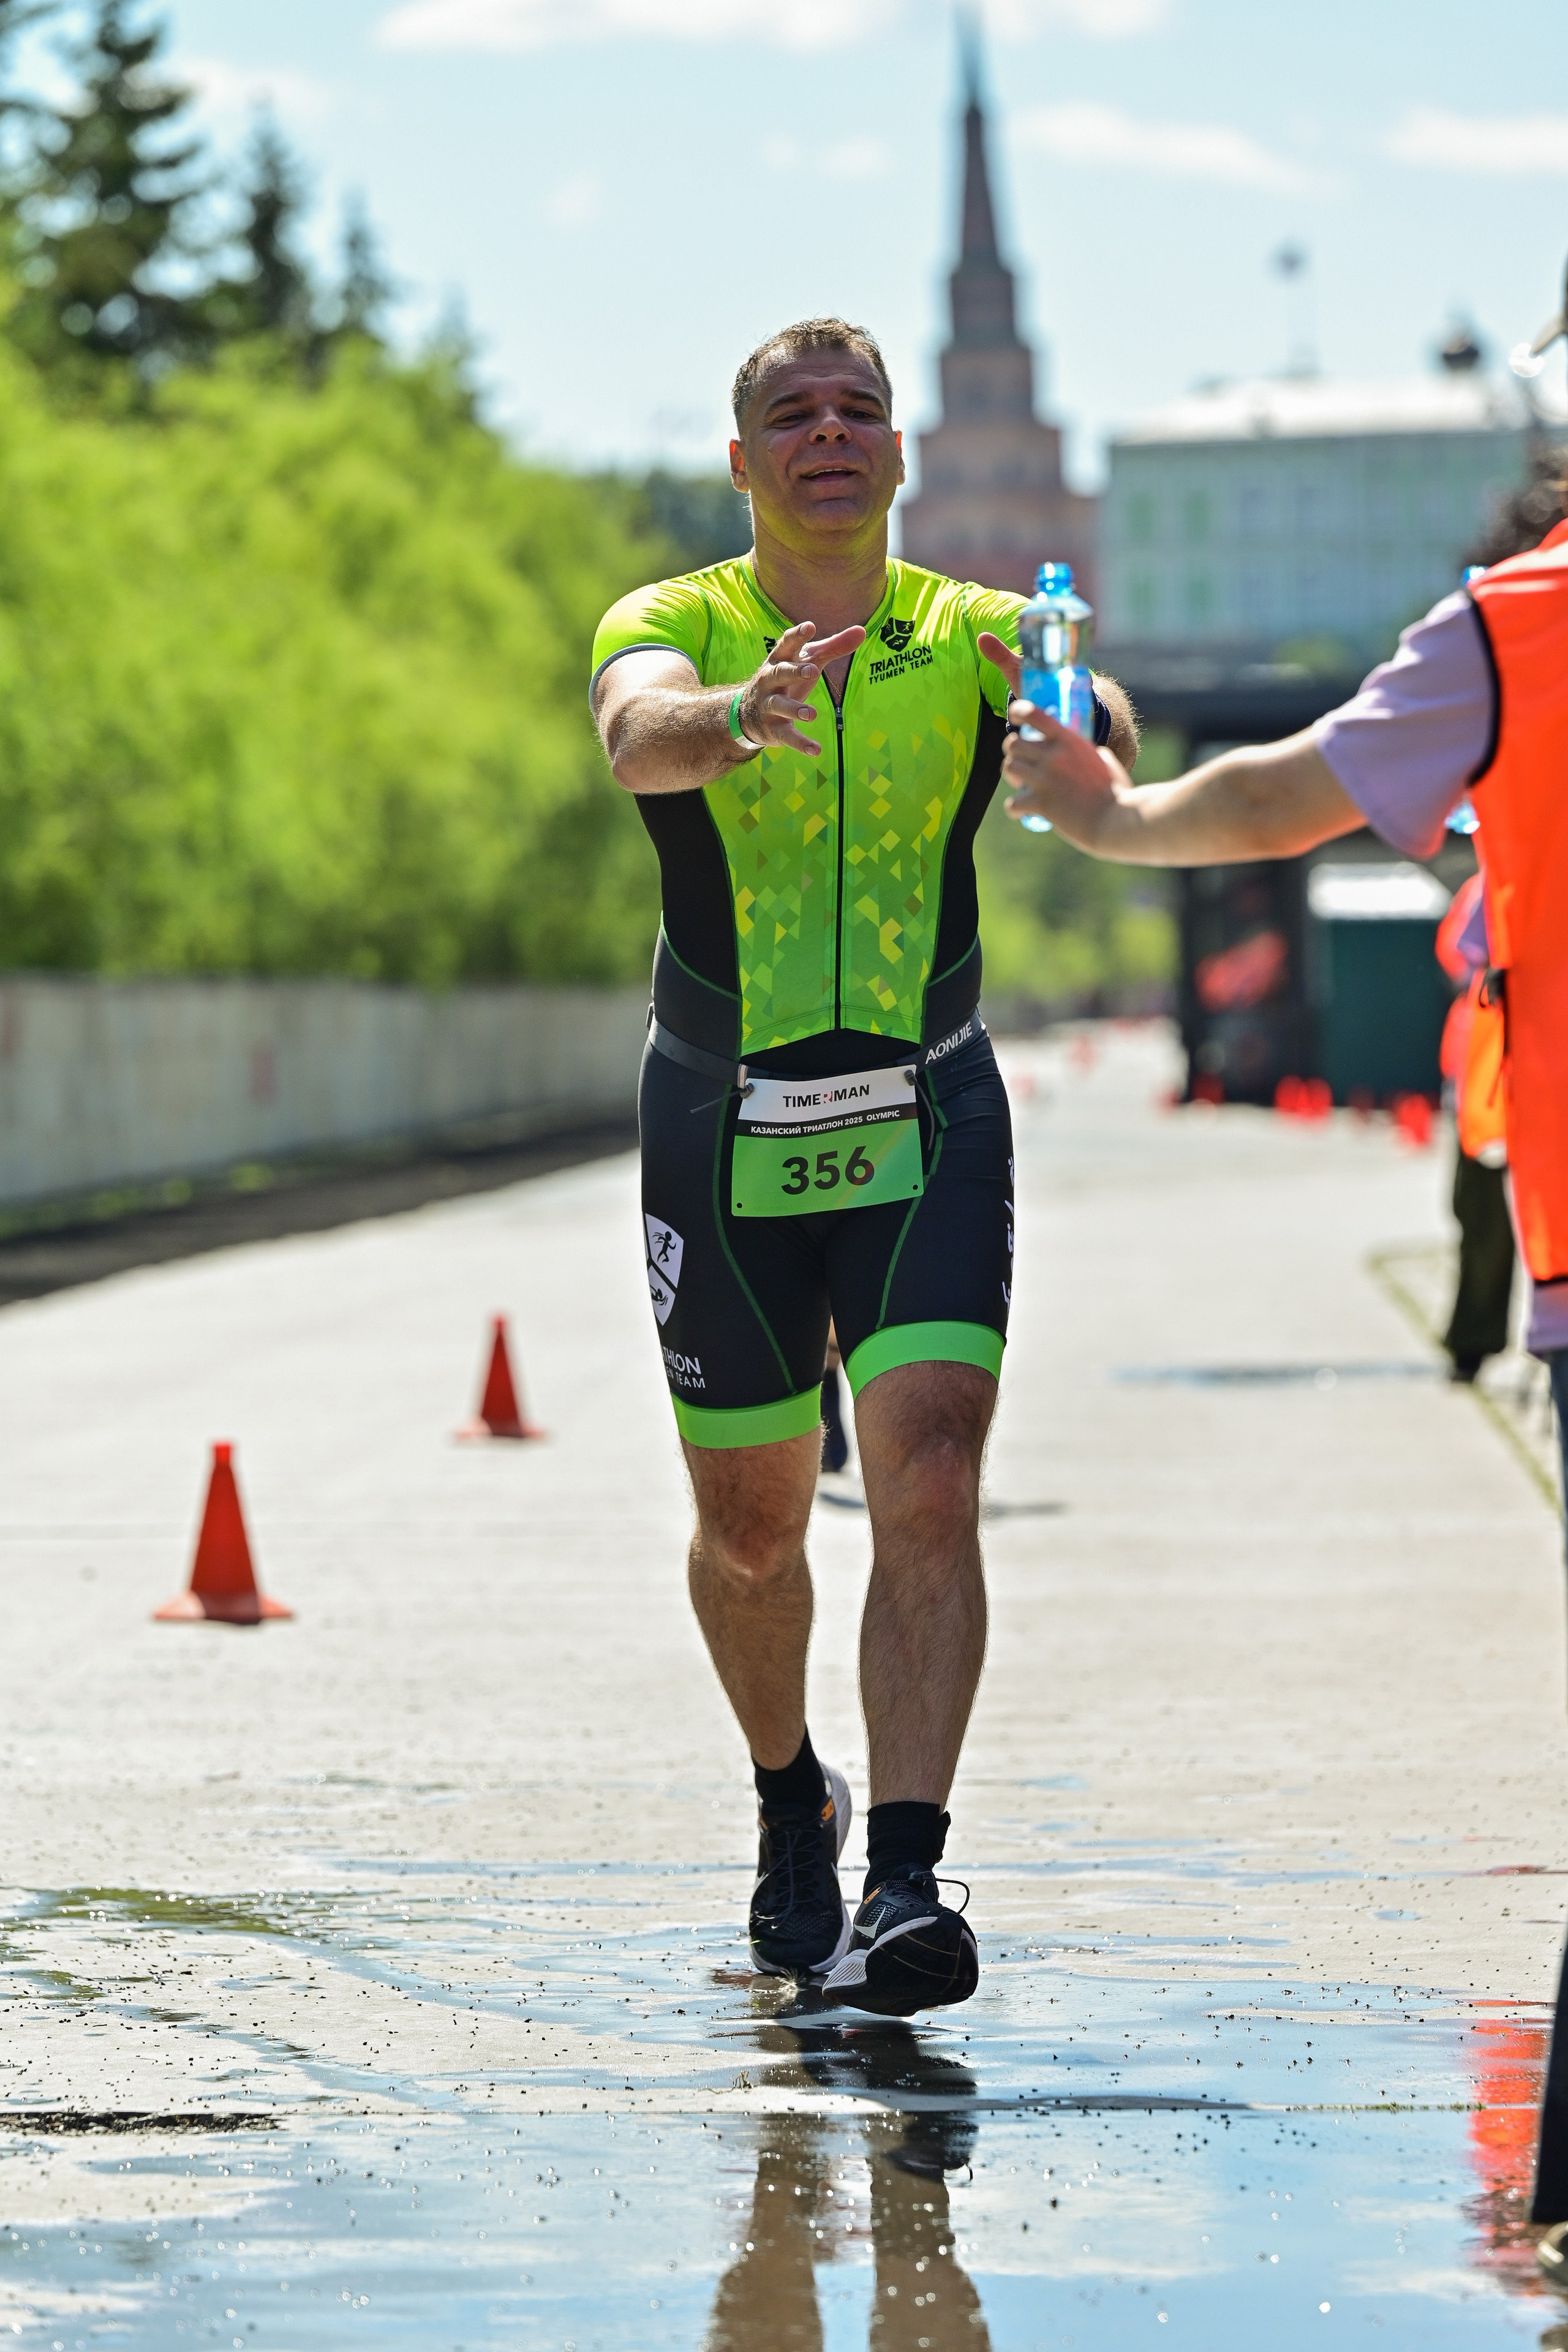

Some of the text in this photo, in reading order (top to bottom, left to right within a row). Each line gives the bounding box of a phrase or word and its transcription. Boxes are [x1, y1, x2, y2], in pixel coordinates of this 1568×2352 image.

[869, 655, 933, 685] TYUMEN TEAM
[870, 645, 932, 675] TRIATHLON
[925, 1021, 973, 1065] AONIJIE
[751, 1110, 900, 1135] КАЗАНСКИЙ ТРИАТЛОН 2025 OLYMPIC
[781, 1145, 875, 1195] 356
[676, 1372, 706, 1389] TEAM
